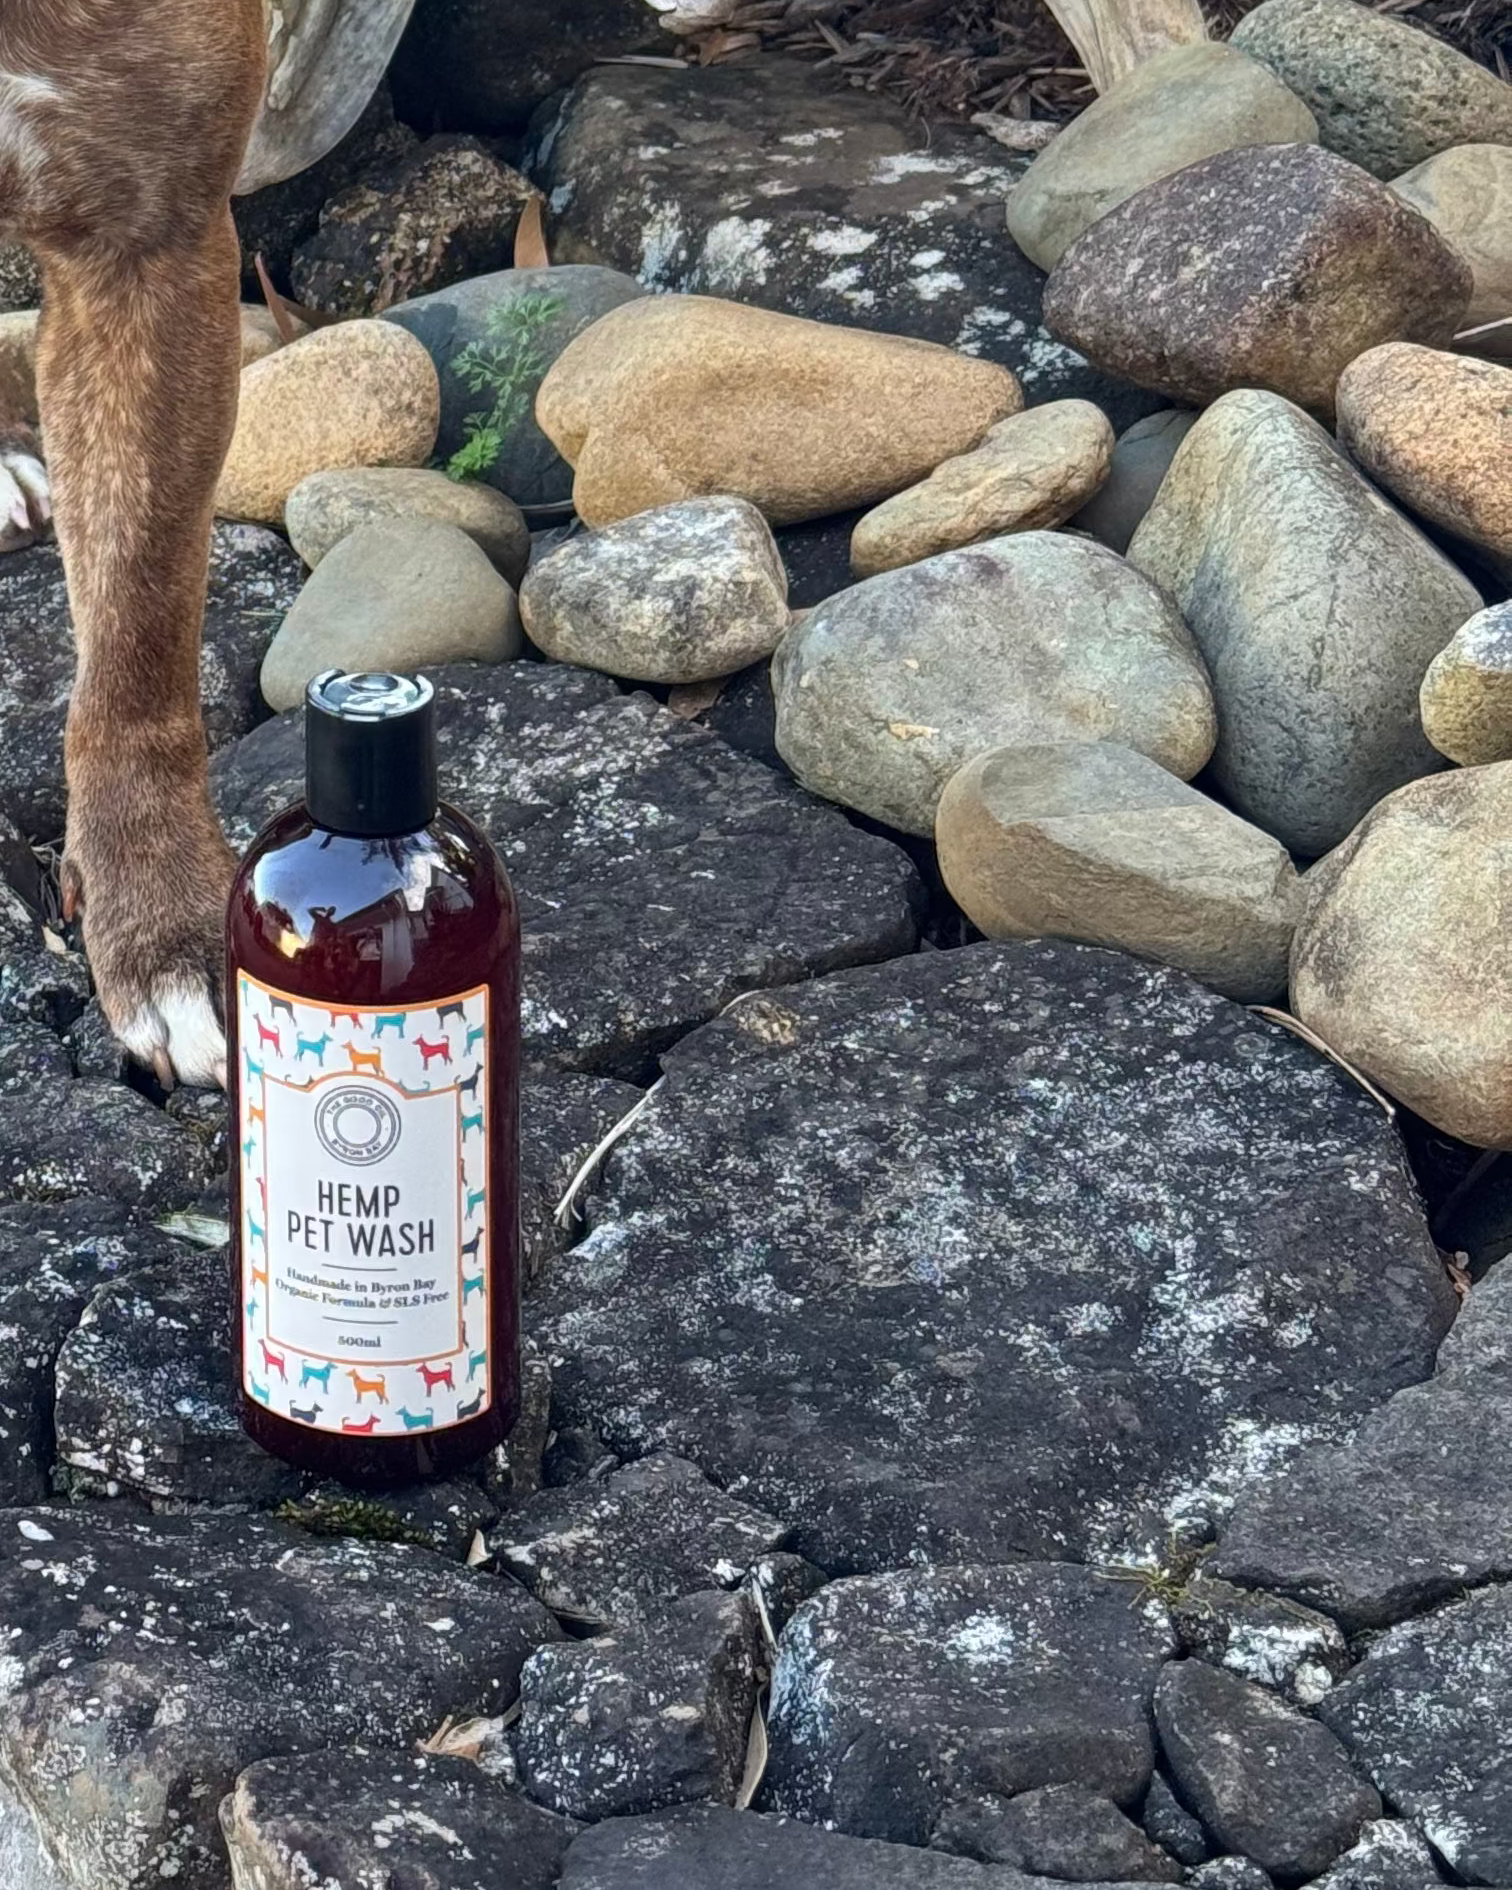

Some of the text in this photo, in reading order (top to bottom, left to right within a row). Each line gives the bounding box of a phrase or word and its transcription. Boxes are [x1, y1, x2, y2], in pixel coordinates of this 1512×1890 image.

[342, 1095, 374, 1106] GOOD
[317, 1179, 400, 1219] HEMP
[287, 1209, 434, 1257] PET WASH
[275, 1277, 450, 1309] Organic Formula & SLS Free
[287, 1266, 437, 1295] Handmade in Byron Bay
[338, 1336, 381, 1348] 500ml
